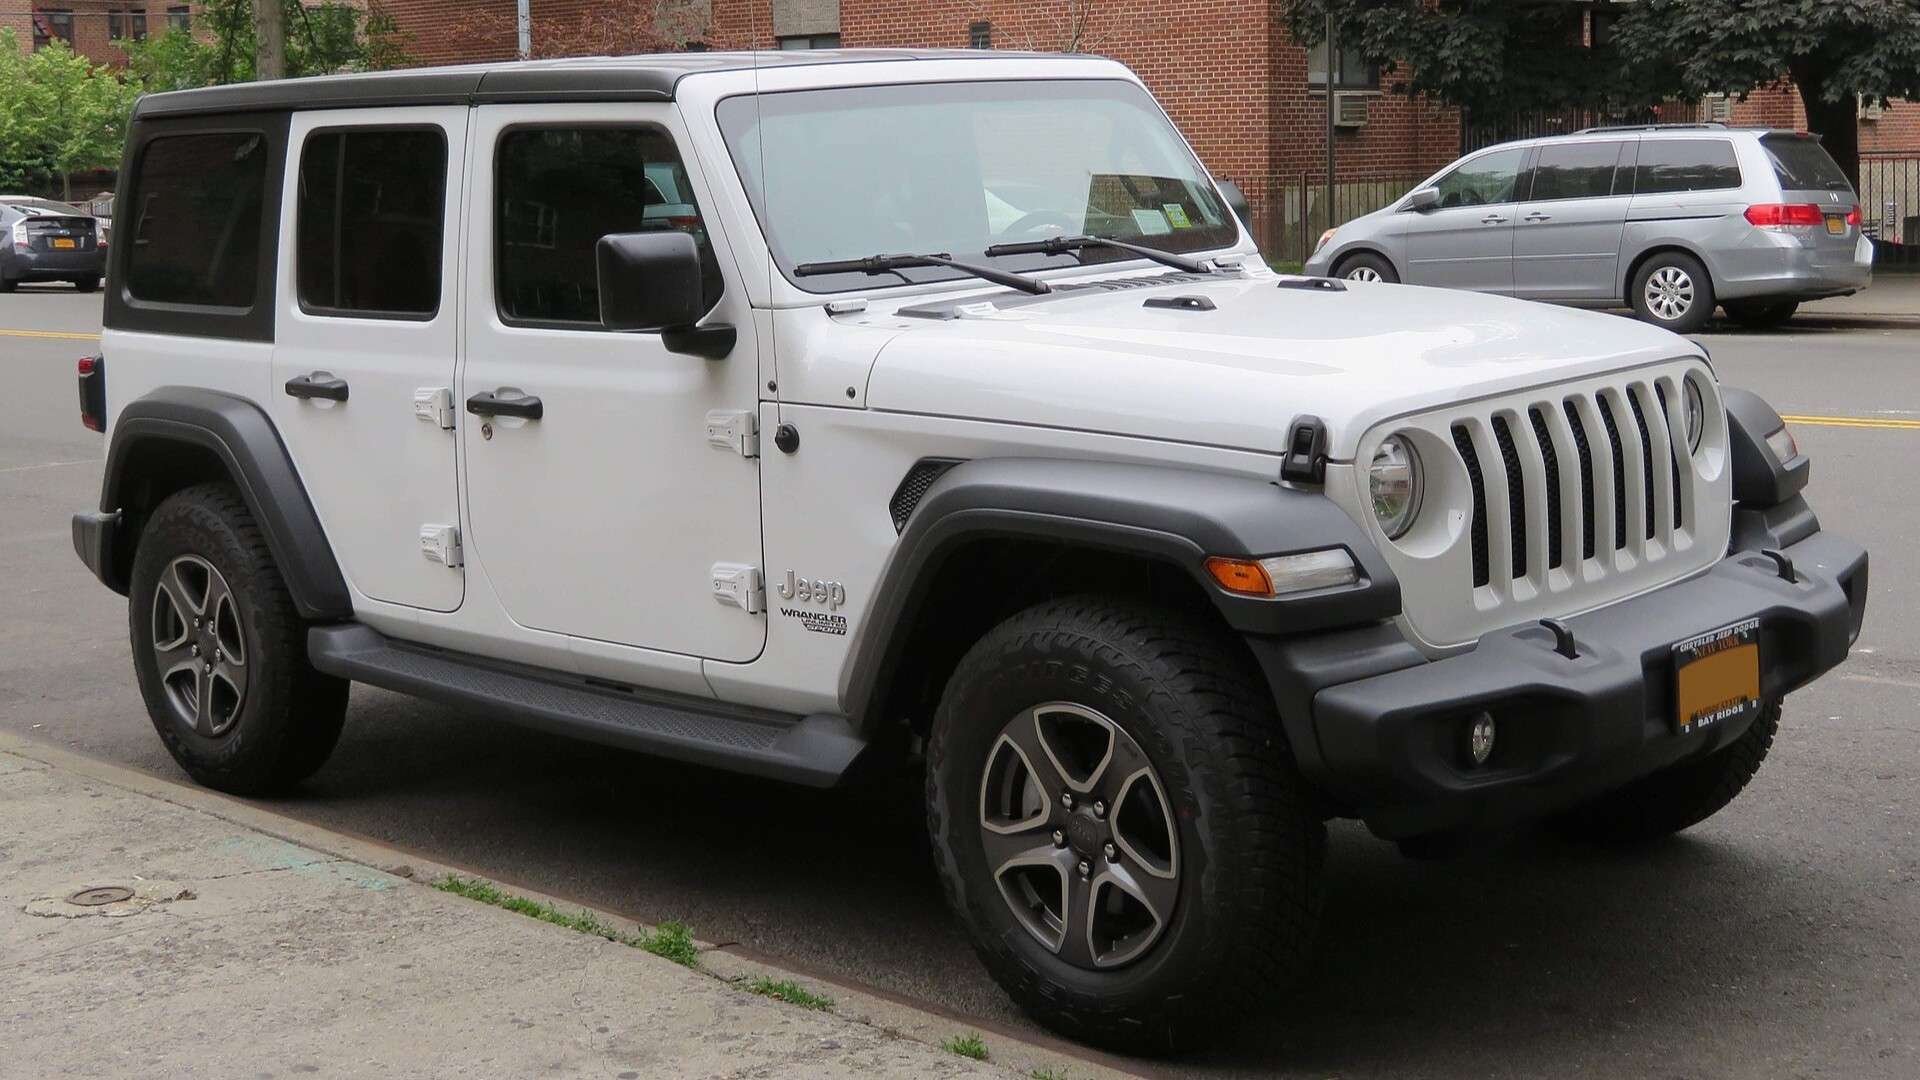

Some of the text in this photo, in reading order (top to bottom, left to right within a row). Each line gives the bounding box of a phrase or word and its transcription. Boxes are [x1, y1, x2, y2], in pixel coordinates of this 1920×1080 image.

[776, 568, 846, 611] Jeep
[780, 607, 847, 624] WRANGLER
[806, 624, 847, 635] SPORT
[1680, 620, 1760, 652] CHRYSLER JEEP DODGE
[1697, 715, 1714, 728] BAY
[1716, 703, 1744, 721] RIDGE
